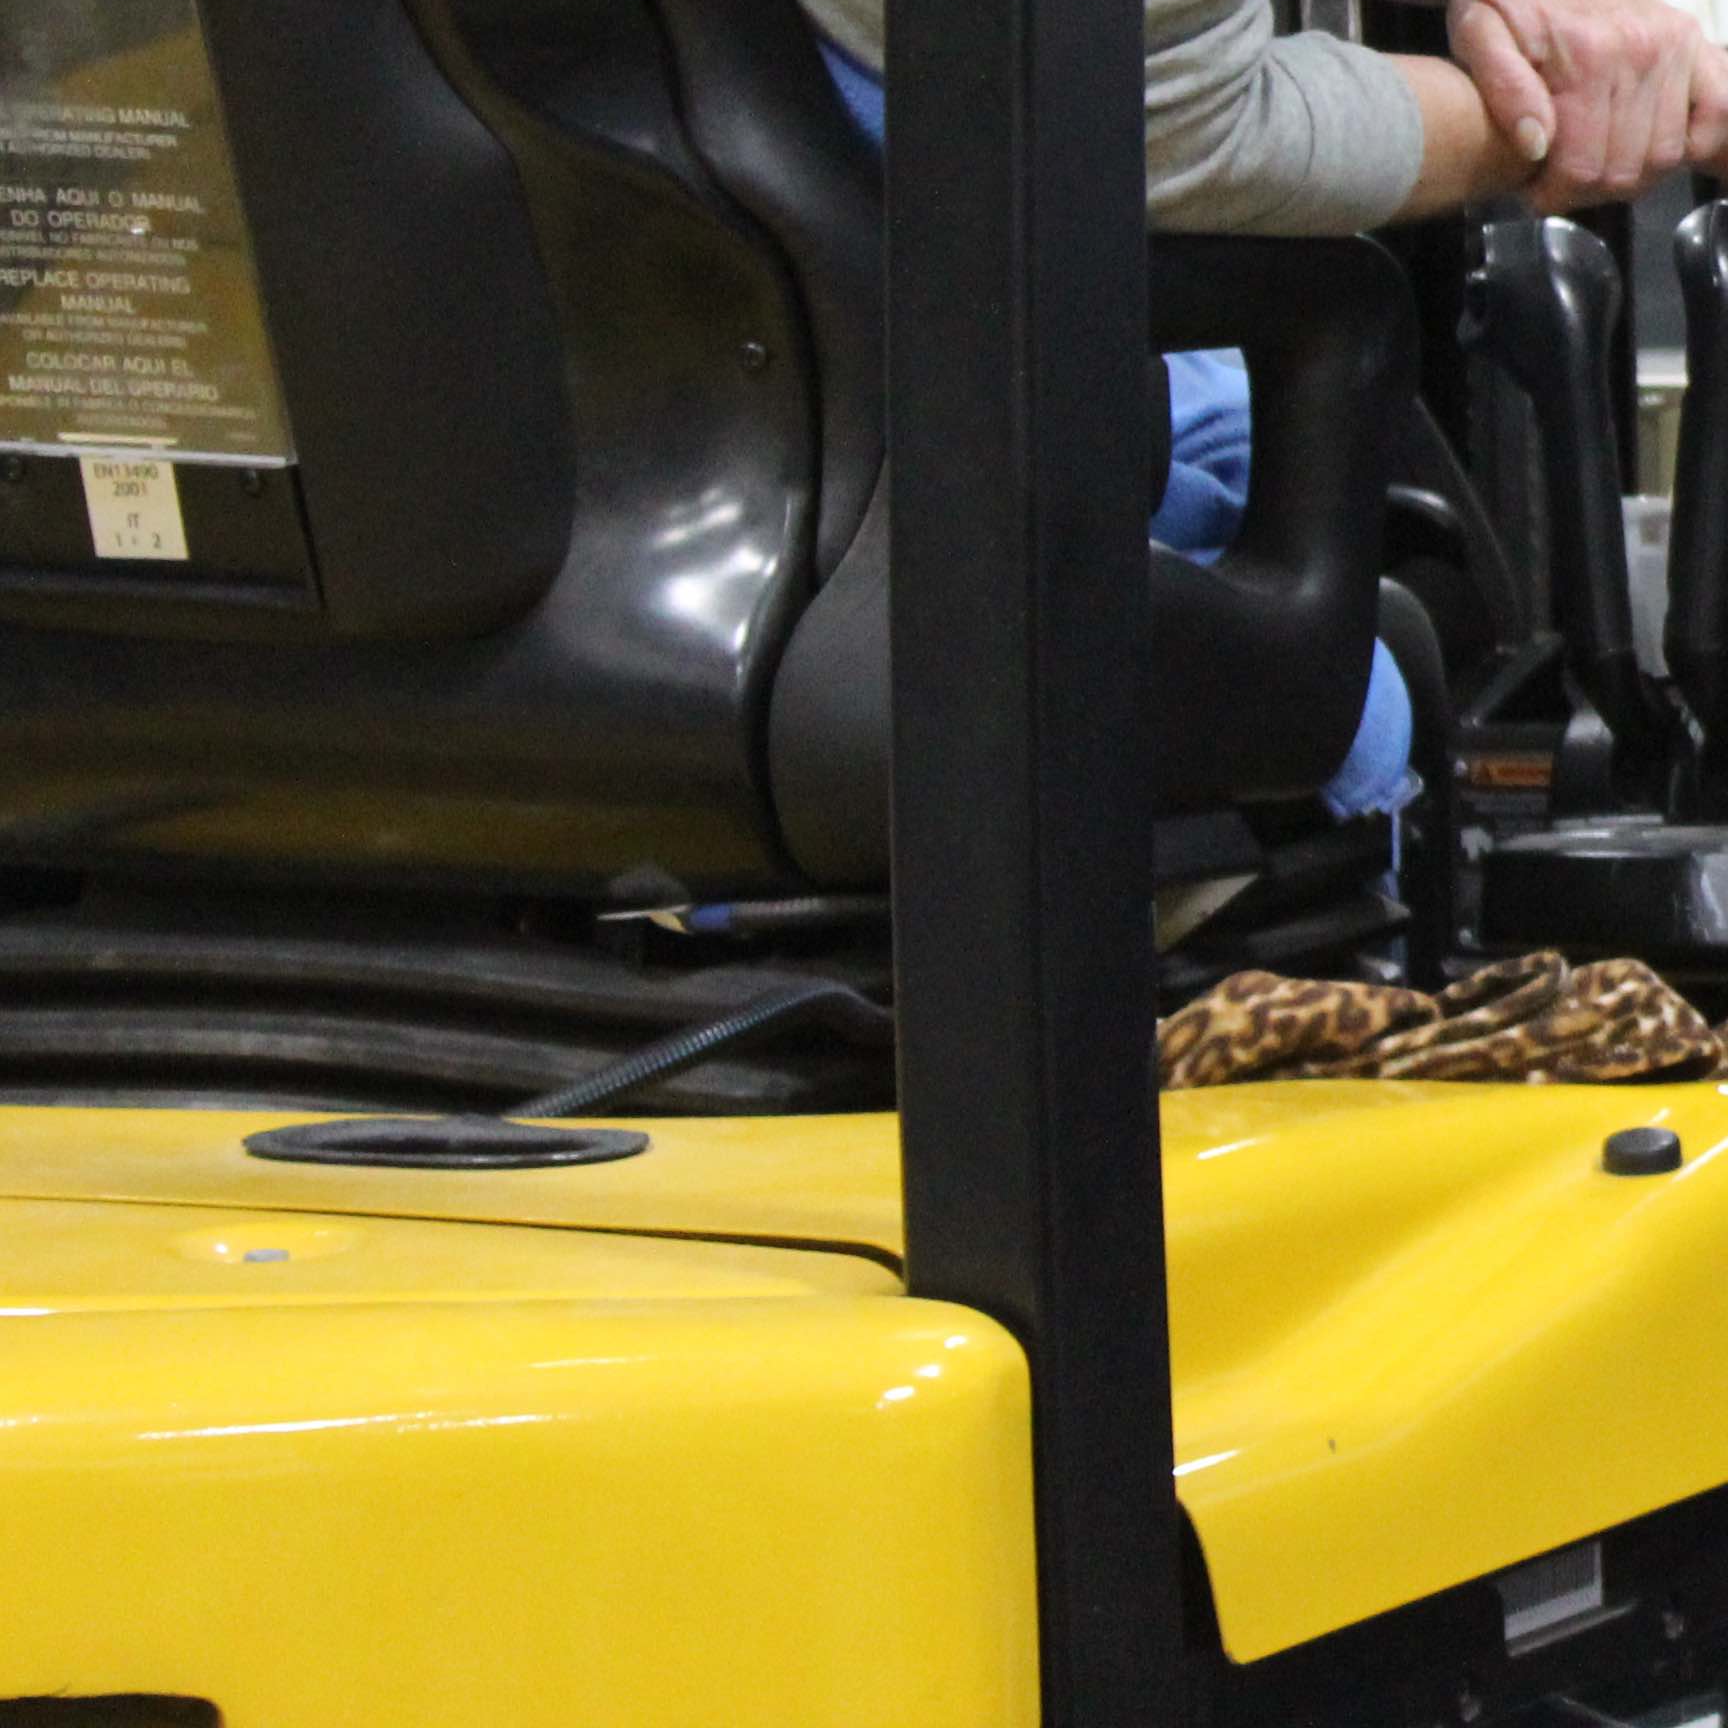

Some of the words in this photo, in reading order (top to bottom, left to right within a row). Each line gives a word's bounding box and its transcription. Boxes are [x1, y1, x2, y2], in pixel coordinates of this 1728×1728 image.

[118, 108, 190, 129] MANUAL
[55, 186, 100, 207] AQUI
[108, 189, 123, 208] O
[132, 192, 205, 214] MANUAL
[10, 209, 39, 227] DO
[0, 269, 80, 289] REPLACE
[86, 272, 191, 295] OPERATING
[61, 294, 136, 314] MANUAL
[26, 350, 117, 371] COLOCAR
[123, 354, 166, 376] AQUI
[171, 357, 195, 378] EL
[8, 374, 88, 394] MANUAL
[90, 377, 123, 396] DEL
